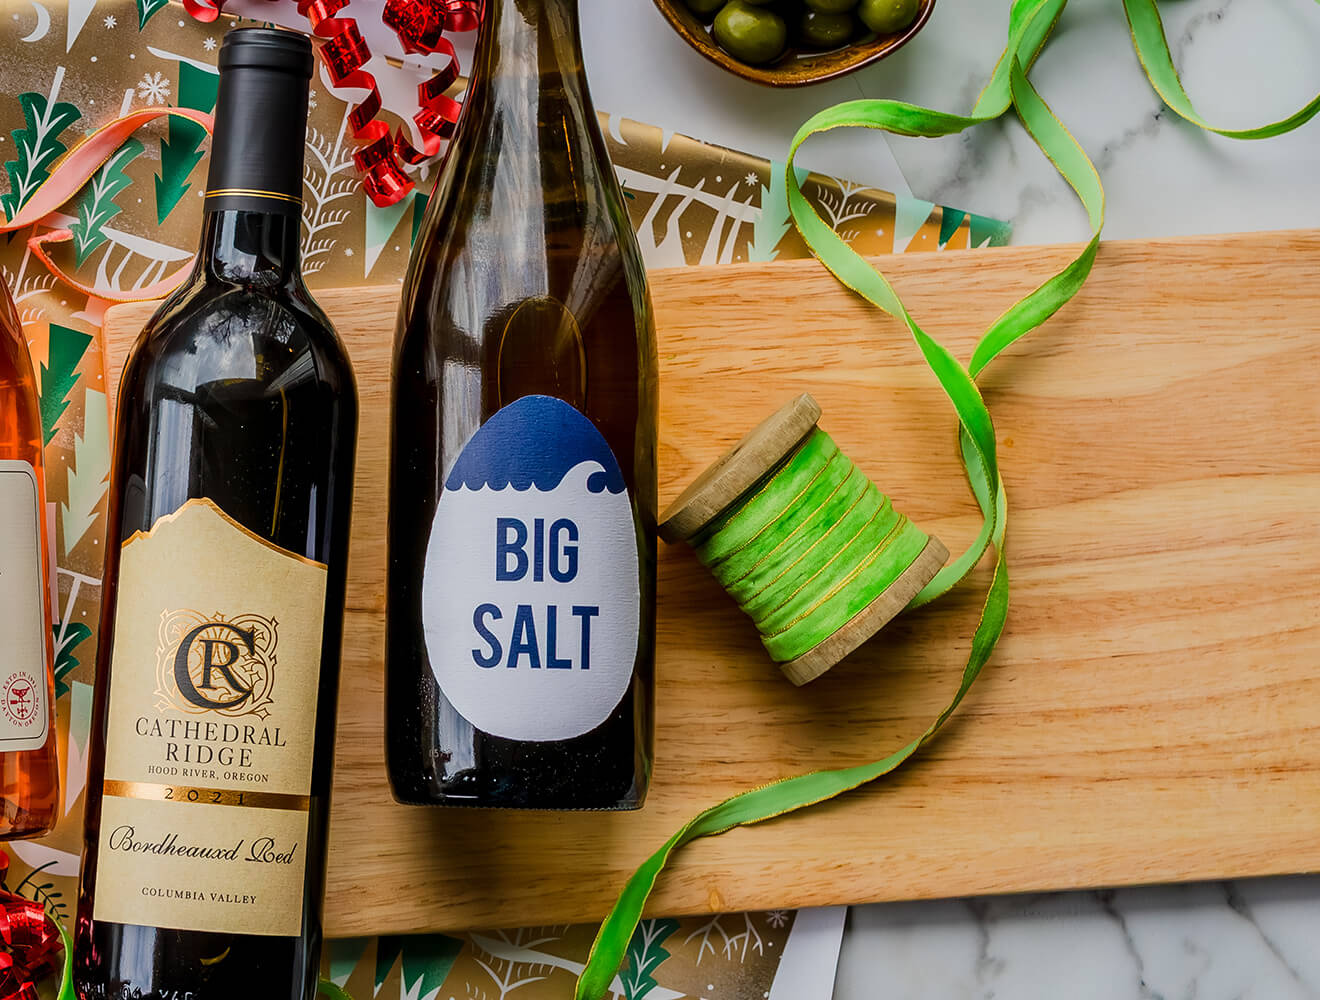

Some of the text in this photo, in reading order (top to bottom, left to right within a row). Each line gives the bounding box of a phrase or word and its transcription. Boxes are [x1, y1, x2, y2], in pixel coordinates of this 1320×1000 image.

[496, 517, 580, 584] BIG
[472, 603, 599, 670] SALT
[135, 717, 287, 747] CATHEDRAL
[165, 743, 253, 768] RIDGE
[148, 766, 269, 783] HOOD RIVER, OREGON
[164, 788, 245, 806] 2021
[109, 825, 298, 865] Bordheauxd Red
[141, 887, 257, 904] COLUMBIA VALLEY
